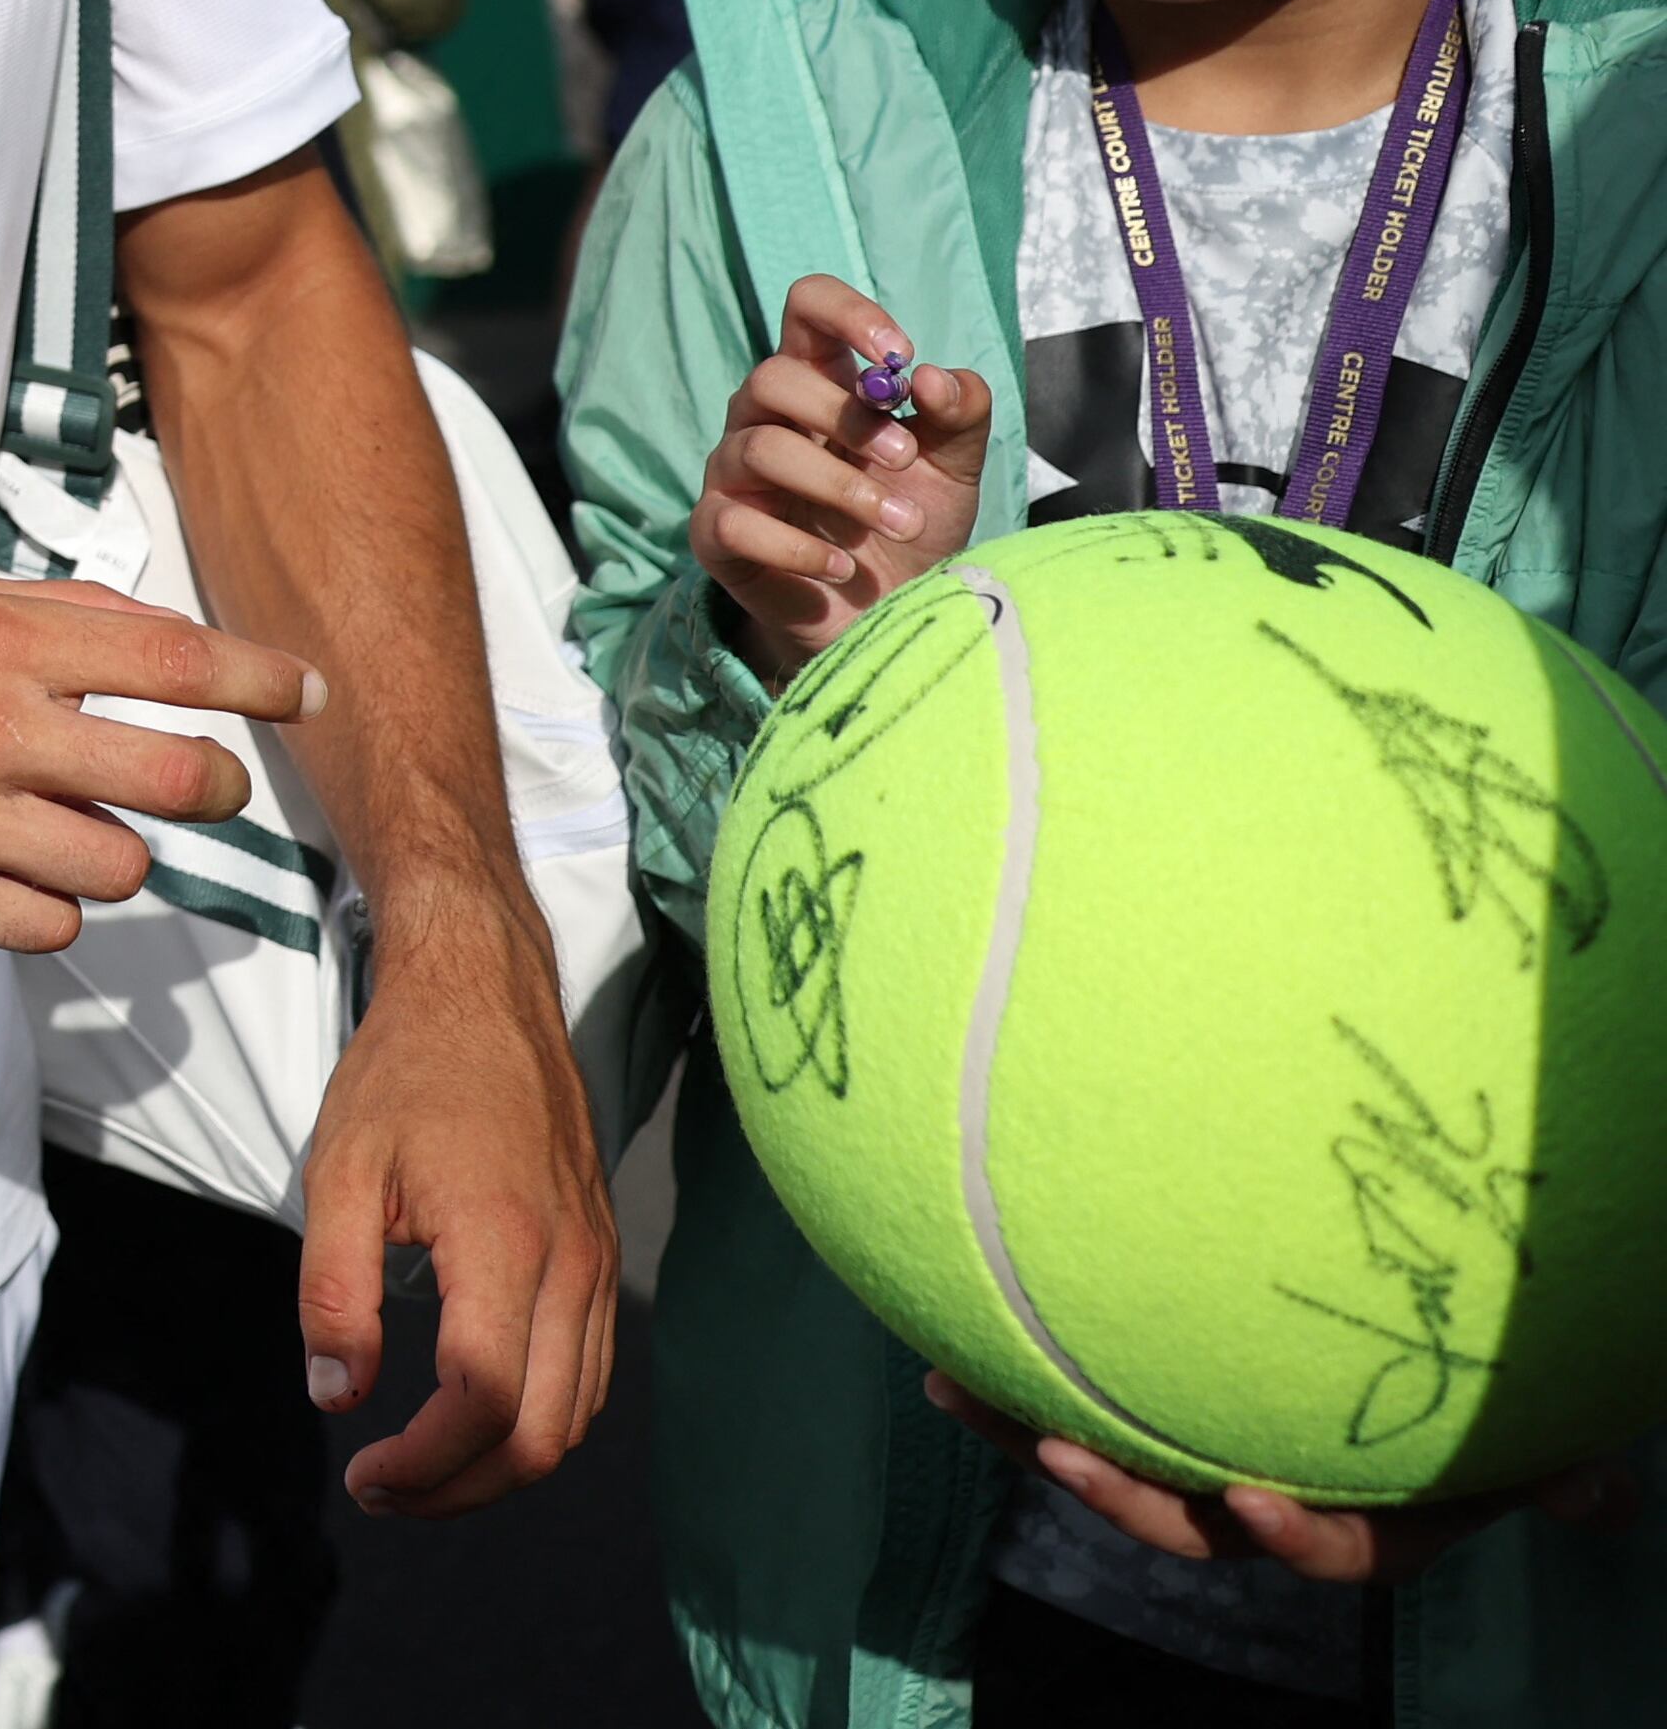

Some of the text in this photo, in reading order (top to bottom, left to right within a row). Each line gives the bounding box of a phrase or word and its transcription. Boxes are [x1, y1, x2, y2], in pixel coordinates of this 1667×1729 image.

[1093, 99, 1132, 173] COURT
[1391, 127, 1435, 208] TICKET
[1114, 174, 1156, 268] CENTRE
[1363, 209, 1405, 303] HOLDER
[1153, 316, 1197, 504] TICKET HOLDER
[1326, 351, 1364, 448] CENTRE
